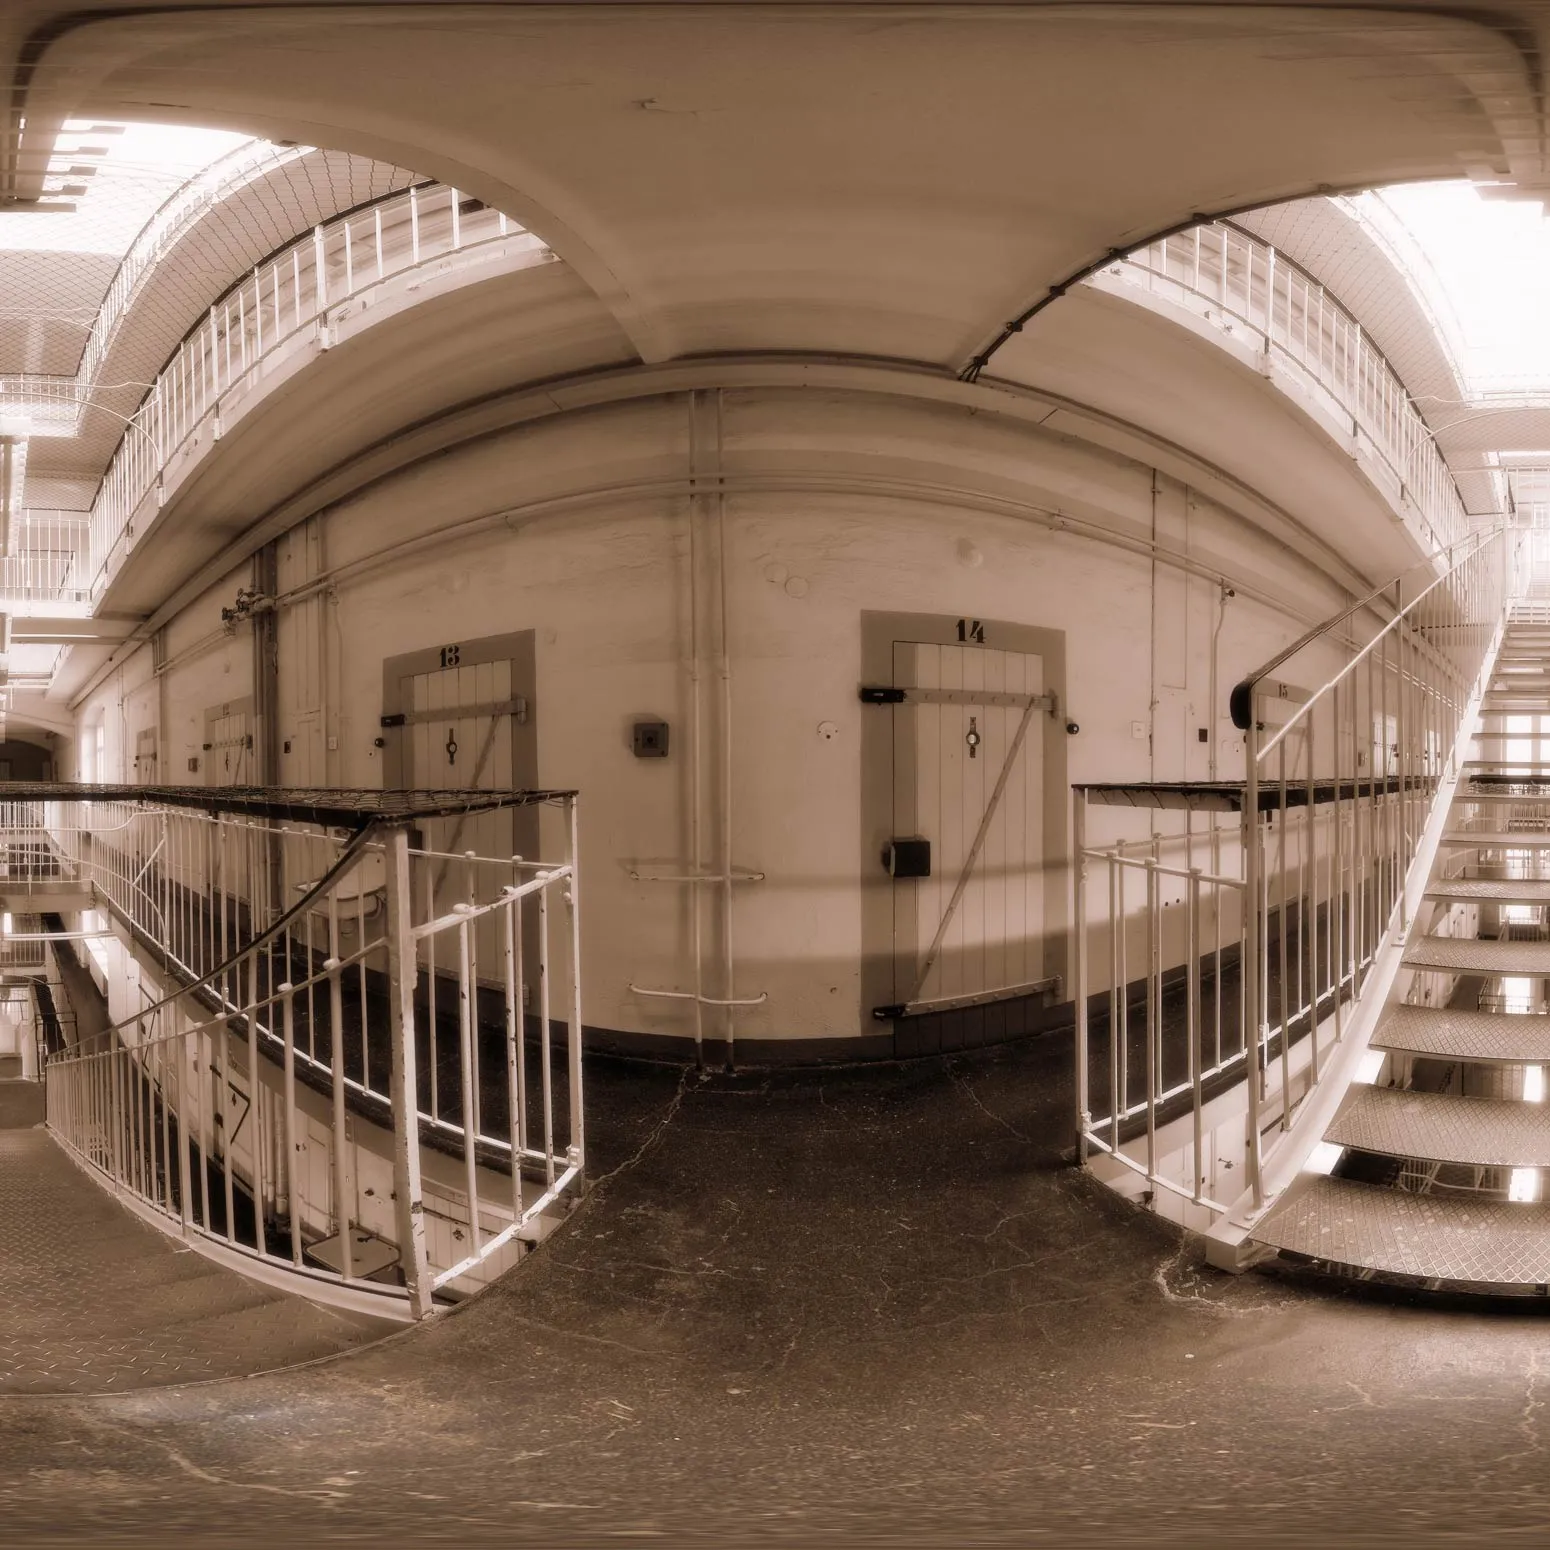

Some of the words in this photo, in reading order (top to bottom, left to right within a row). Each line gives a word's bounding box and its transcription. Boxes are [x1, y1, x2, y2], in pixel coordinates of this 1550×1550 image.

[956, 619, 985, 643] 14
[439, 645, 460, 668] 13
[1278, 683, 1288, 699] 15
